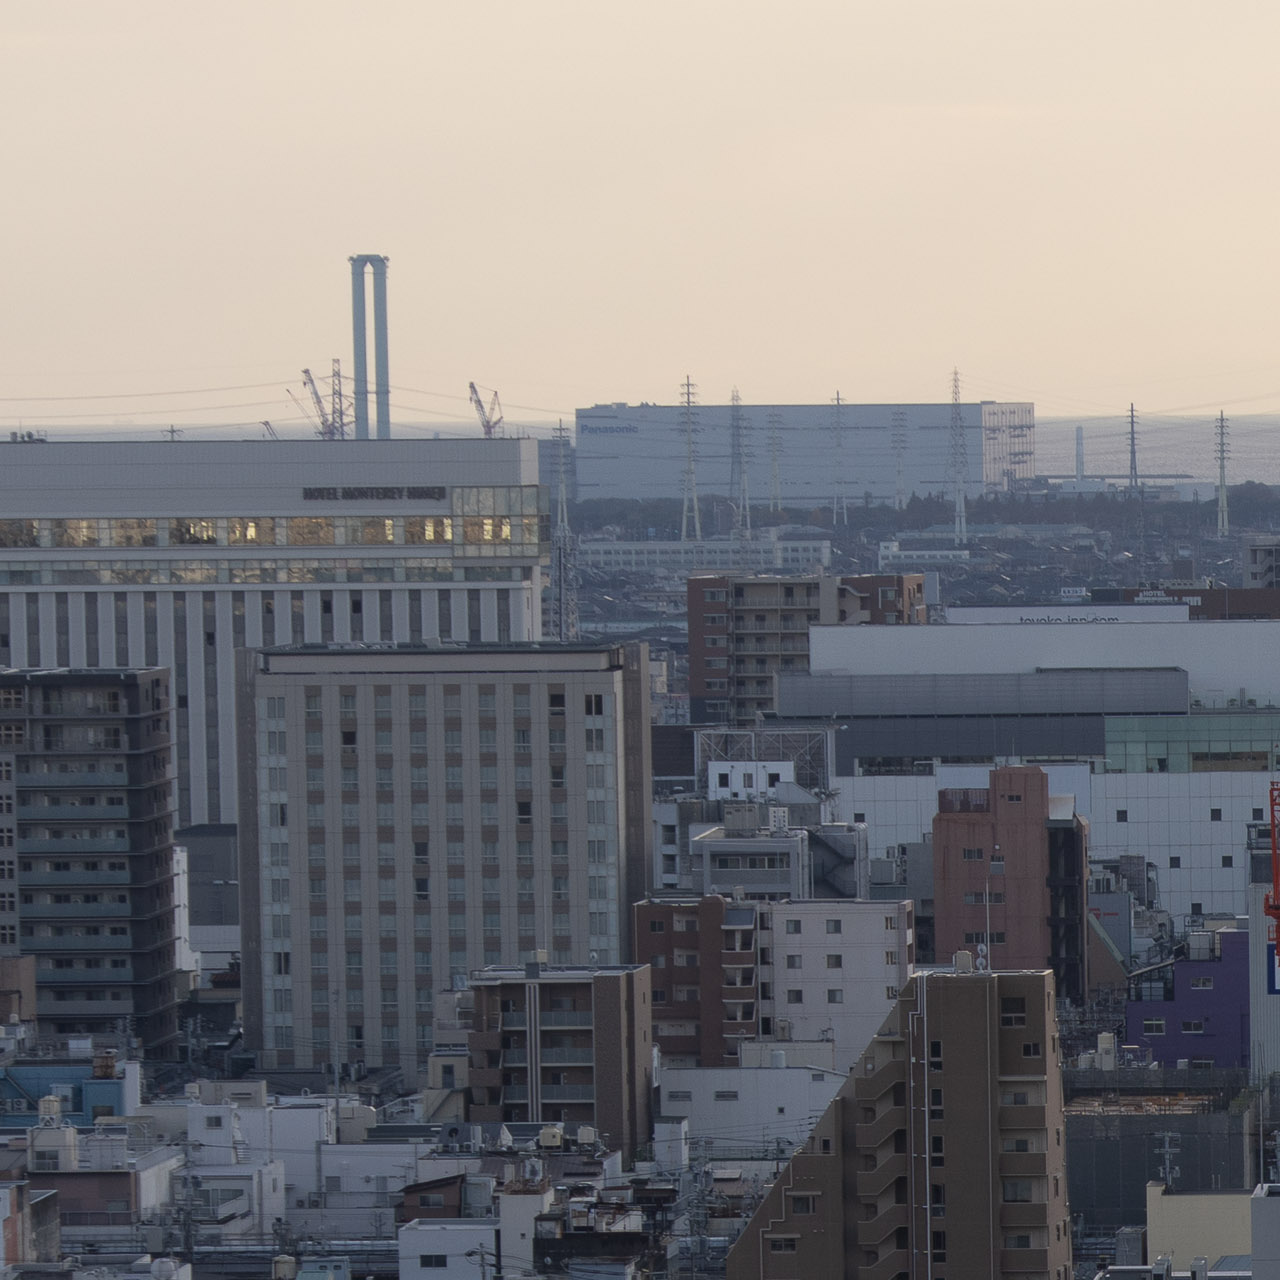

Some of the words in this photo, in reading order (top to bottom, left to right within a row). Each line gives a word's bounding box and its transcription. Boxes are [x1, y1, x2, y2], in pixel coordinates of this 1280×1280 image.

[580, 424, 639, 434] Panasonic
[303, 487, 339, 500] HOTEL
[342, 487, 406, 500] MONTEREY
